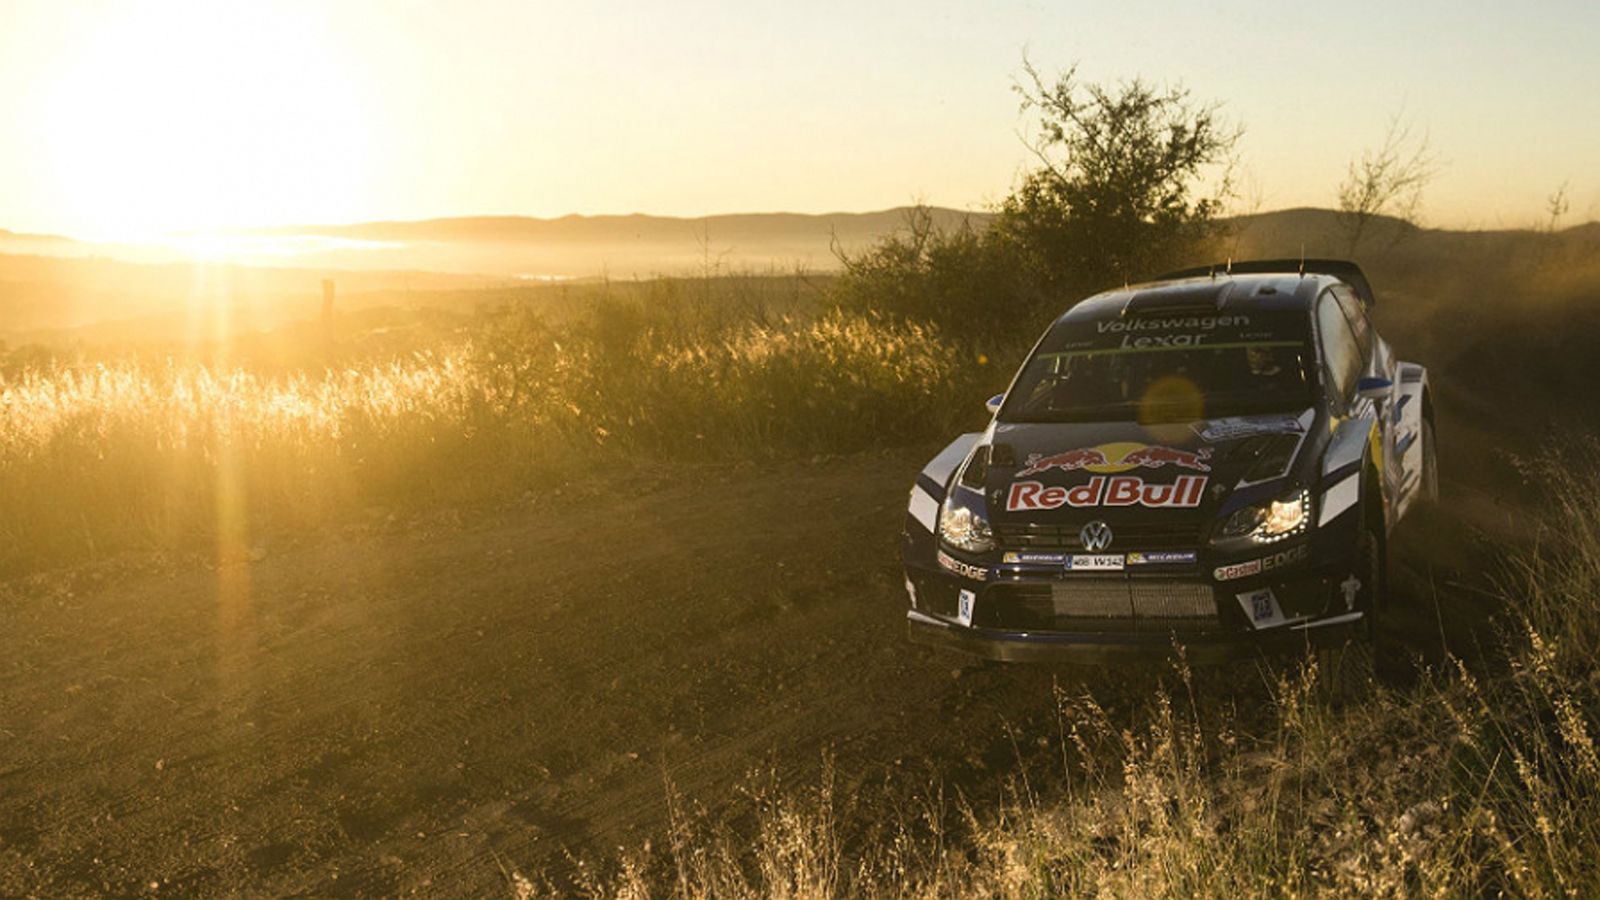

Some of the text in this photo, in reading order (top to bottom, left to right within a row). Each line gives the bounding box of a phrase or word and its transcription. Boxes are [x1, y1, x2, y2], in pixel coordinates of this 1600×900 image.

[1096, 314, 1249, 334] Volkswagen
[1121, 334, 1207, 350] Lexar
[1006, 475, 1209, 511] Red Bull
[1263, 544, 1307, 570] EDGE
[952, 560, 989, 582] EDGE
